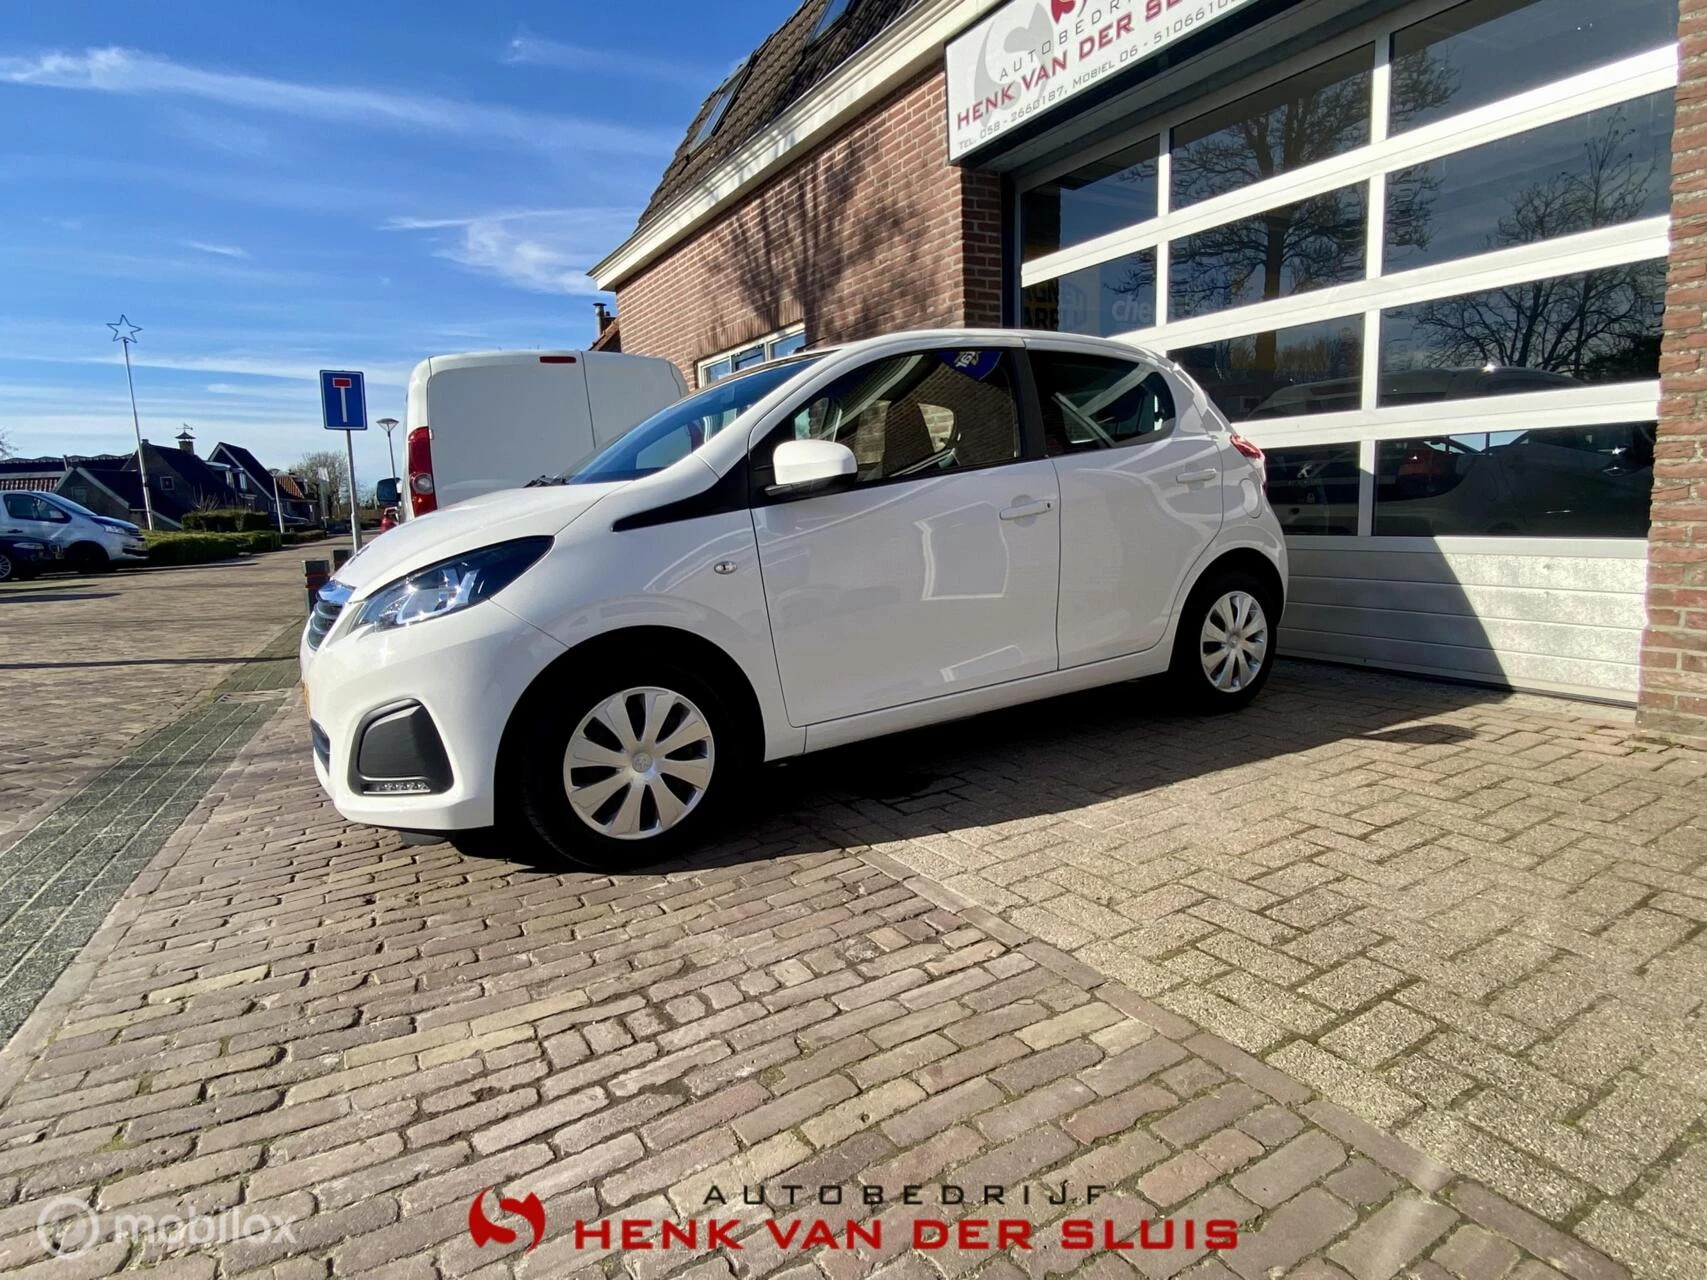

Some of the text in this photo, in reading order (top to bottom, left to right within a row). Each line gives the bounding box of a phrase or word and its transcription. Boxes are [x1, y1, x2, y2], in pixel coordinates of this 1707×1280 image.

[957, 80, 1016, 131] HENK
[1021, 50, 1068, 91] VAN
[1079, 12, 1135, 61] DER
[999, 0, 1132, 81] AUTOBEDR
[1072, 59, 1116, 89] MOBIEL
[1119, 44, 1139, 63] 06
[1153, 0, 1238, 45] 5106610
